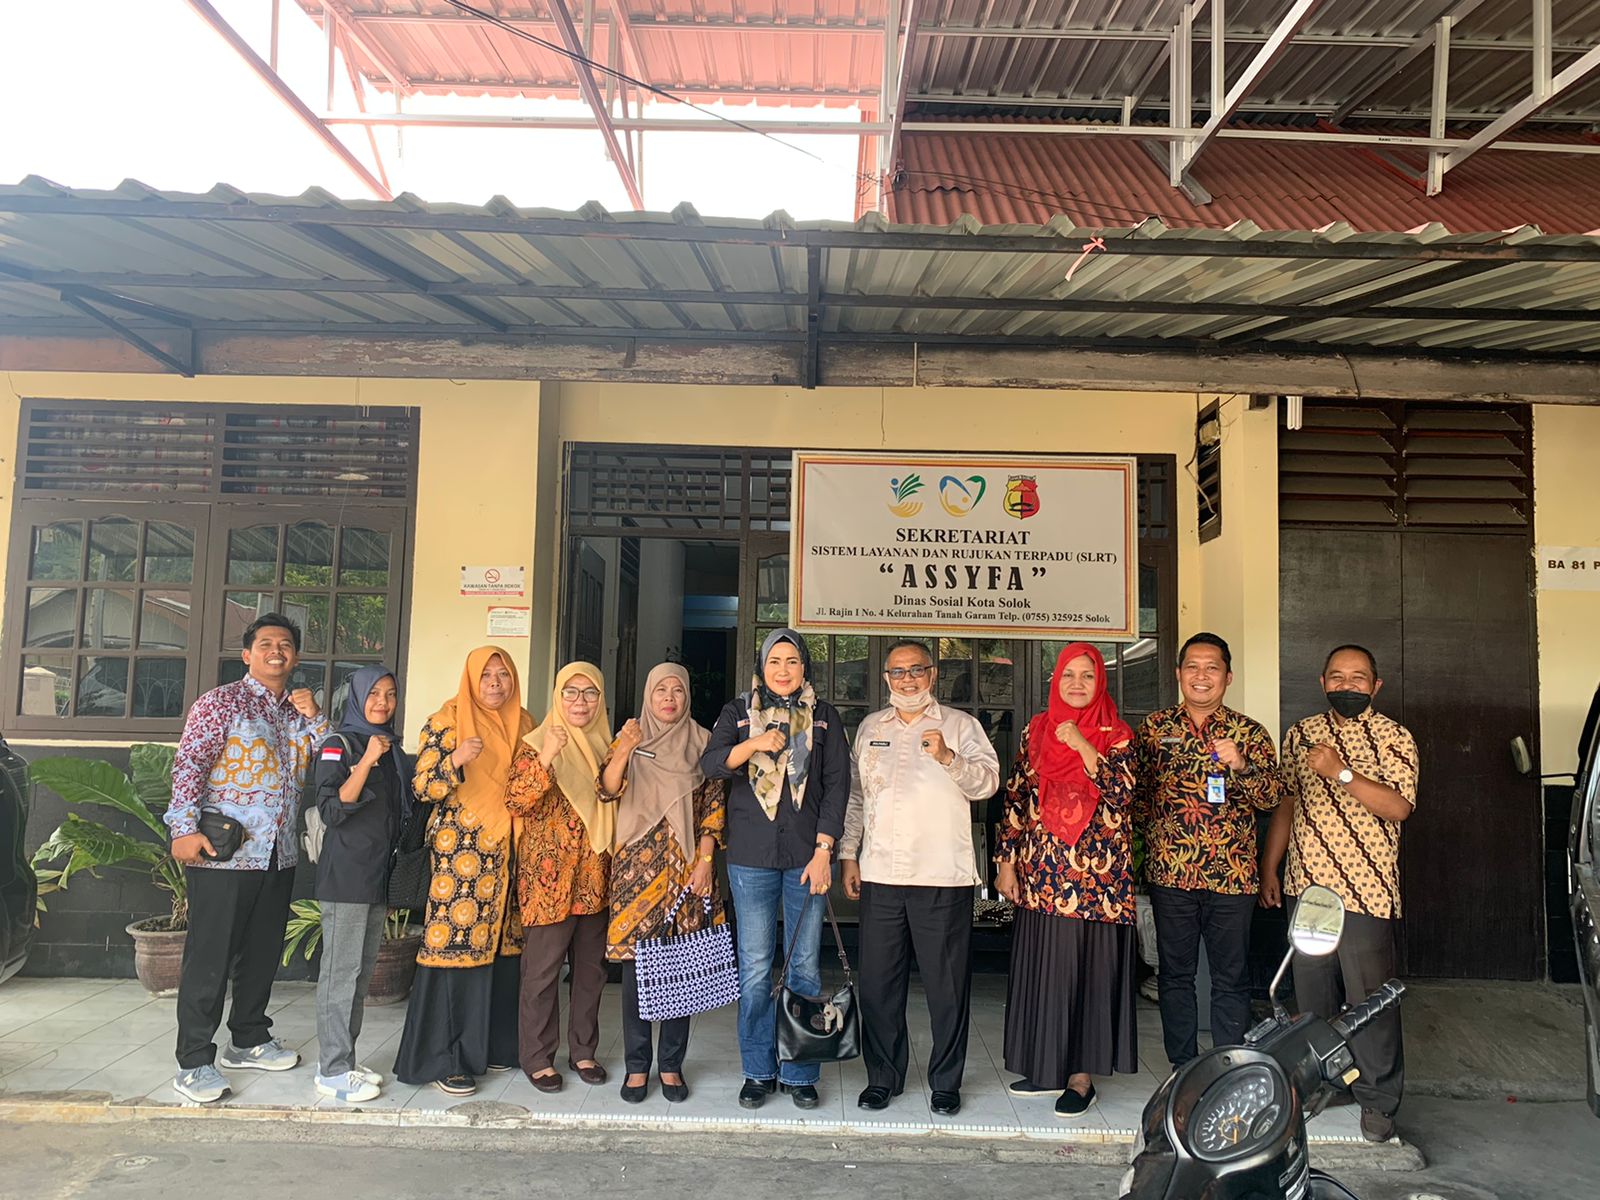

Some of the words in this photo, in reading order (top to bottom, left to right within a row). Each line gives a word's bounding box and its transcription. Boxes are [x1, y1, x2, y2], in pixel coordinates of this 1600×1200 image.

[896, 528, 1030, 545] SEKRETARIAT
[811, 546, 858, 557] SISTEM
[861, 547, 919, 558] LAYANAN
[922, 548, 949, 559] DAN
[952, 549, 1011, 560] RUJUKAN
[1014, 550, 1073, 562] TERPADU
[1077, 552, 1117, 564] (SLRT)
[1548, 560, 1565, 569] BA
[1572, 561, 1585, 569] 81
[894, 595, 927, 606] Dinas
[929, 596, 963, 607] Sosial
[967, 596, 995, 608] Kota
[998, 596, 1031, 609] Solok
[816, 608, 826, 616] Jl.
[829, 608, 852, 618] Rajin
[861, 609, 876, 617] No.
[879, 609, 884, 617] 4
[887, 609, 933, 619] Kelurahan
[935, 610, 962, 620] Tanah
[964, 611, 996, 620] Garam
[998, 611, 1020, 622] Telp.
[1022, 612, 1050, 622] (0755)
[1052, 613, 1083, 622] 325925
[1086, 613, 1110, 623] Solok
